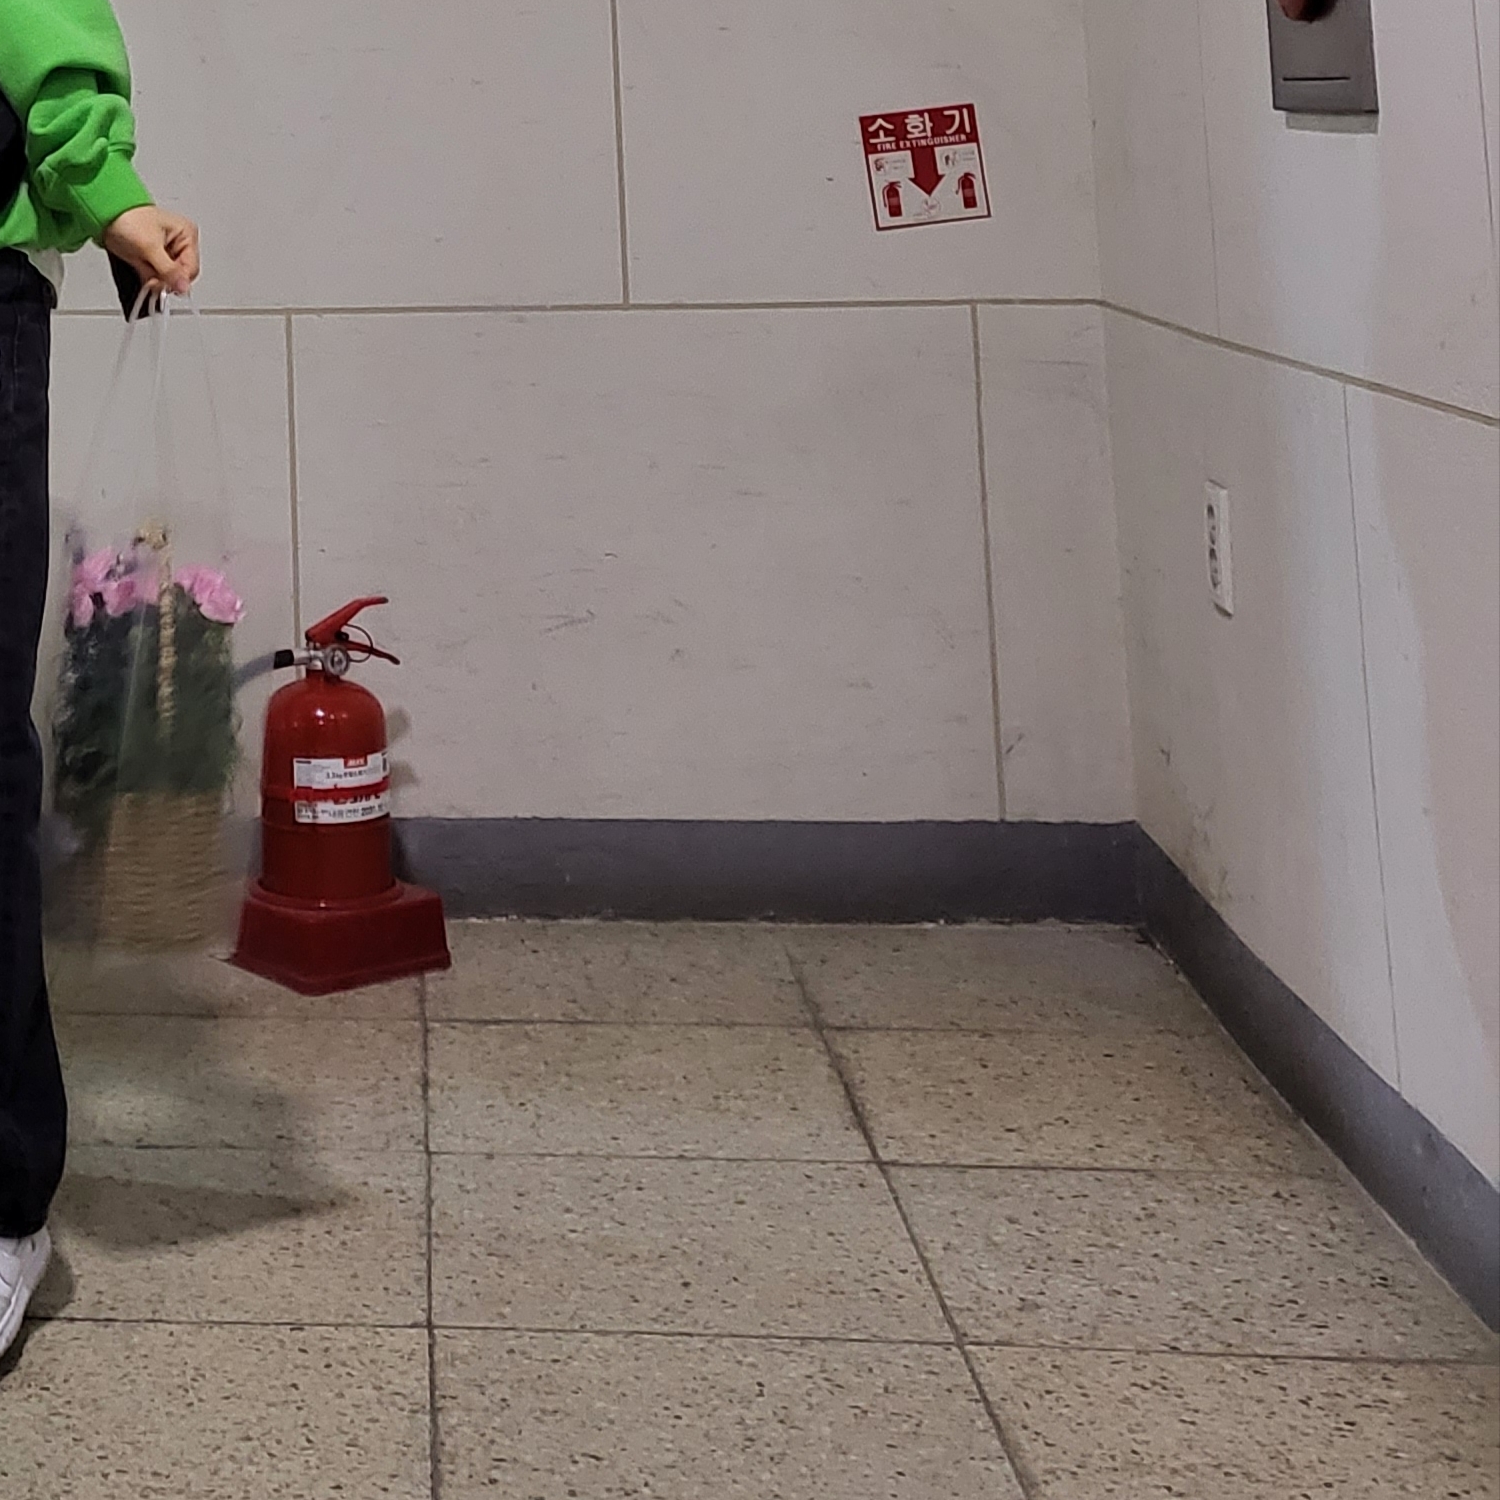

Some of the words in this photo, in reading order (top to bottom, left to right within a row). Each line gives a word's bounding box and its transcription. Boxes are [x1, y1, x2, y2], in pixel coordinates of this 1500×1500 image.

[868, 107, 971, 144] 소화기
[877, 142, 897, 152] FIRE
[899, 134, 967, 149] EXTINGUISHER
